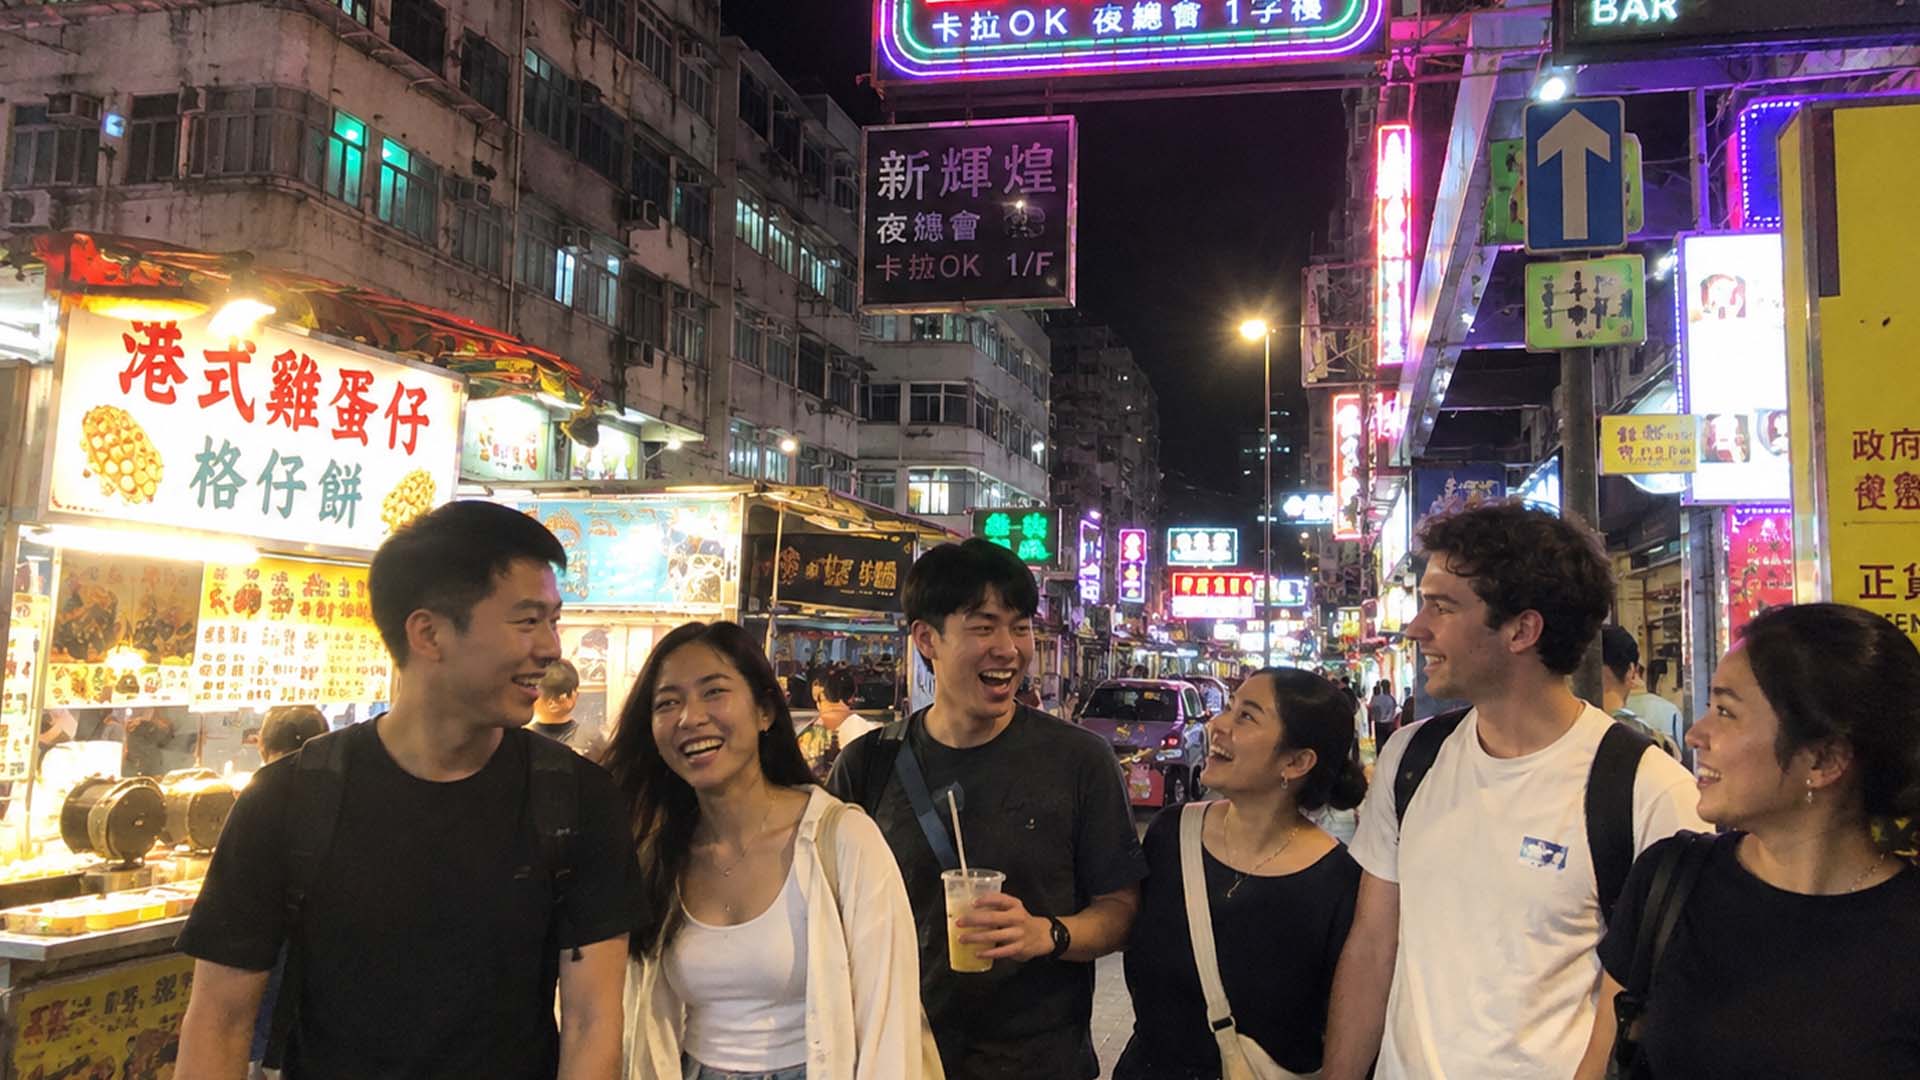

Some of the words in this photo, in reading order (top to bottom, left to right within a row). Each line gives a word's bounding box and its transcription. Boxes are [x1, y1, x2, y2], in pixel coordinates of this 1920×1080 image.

[932, 8, 1068, 43] 卡拉OK
[1592, 0, 1678, 25] BAR
[877, 143, 1056, 201] 新輝煌
[877, 209, 981, 244] 夜總會
[876, 253, 982, 282] 卡拉OK
[1007, 251, 1054, 277] 1/F
[117, 320, 430, 456] 港式雞蛋仔
[1853, 428, 1920, 461] 政府
[189, 434, 363, 529] 格仔餅
